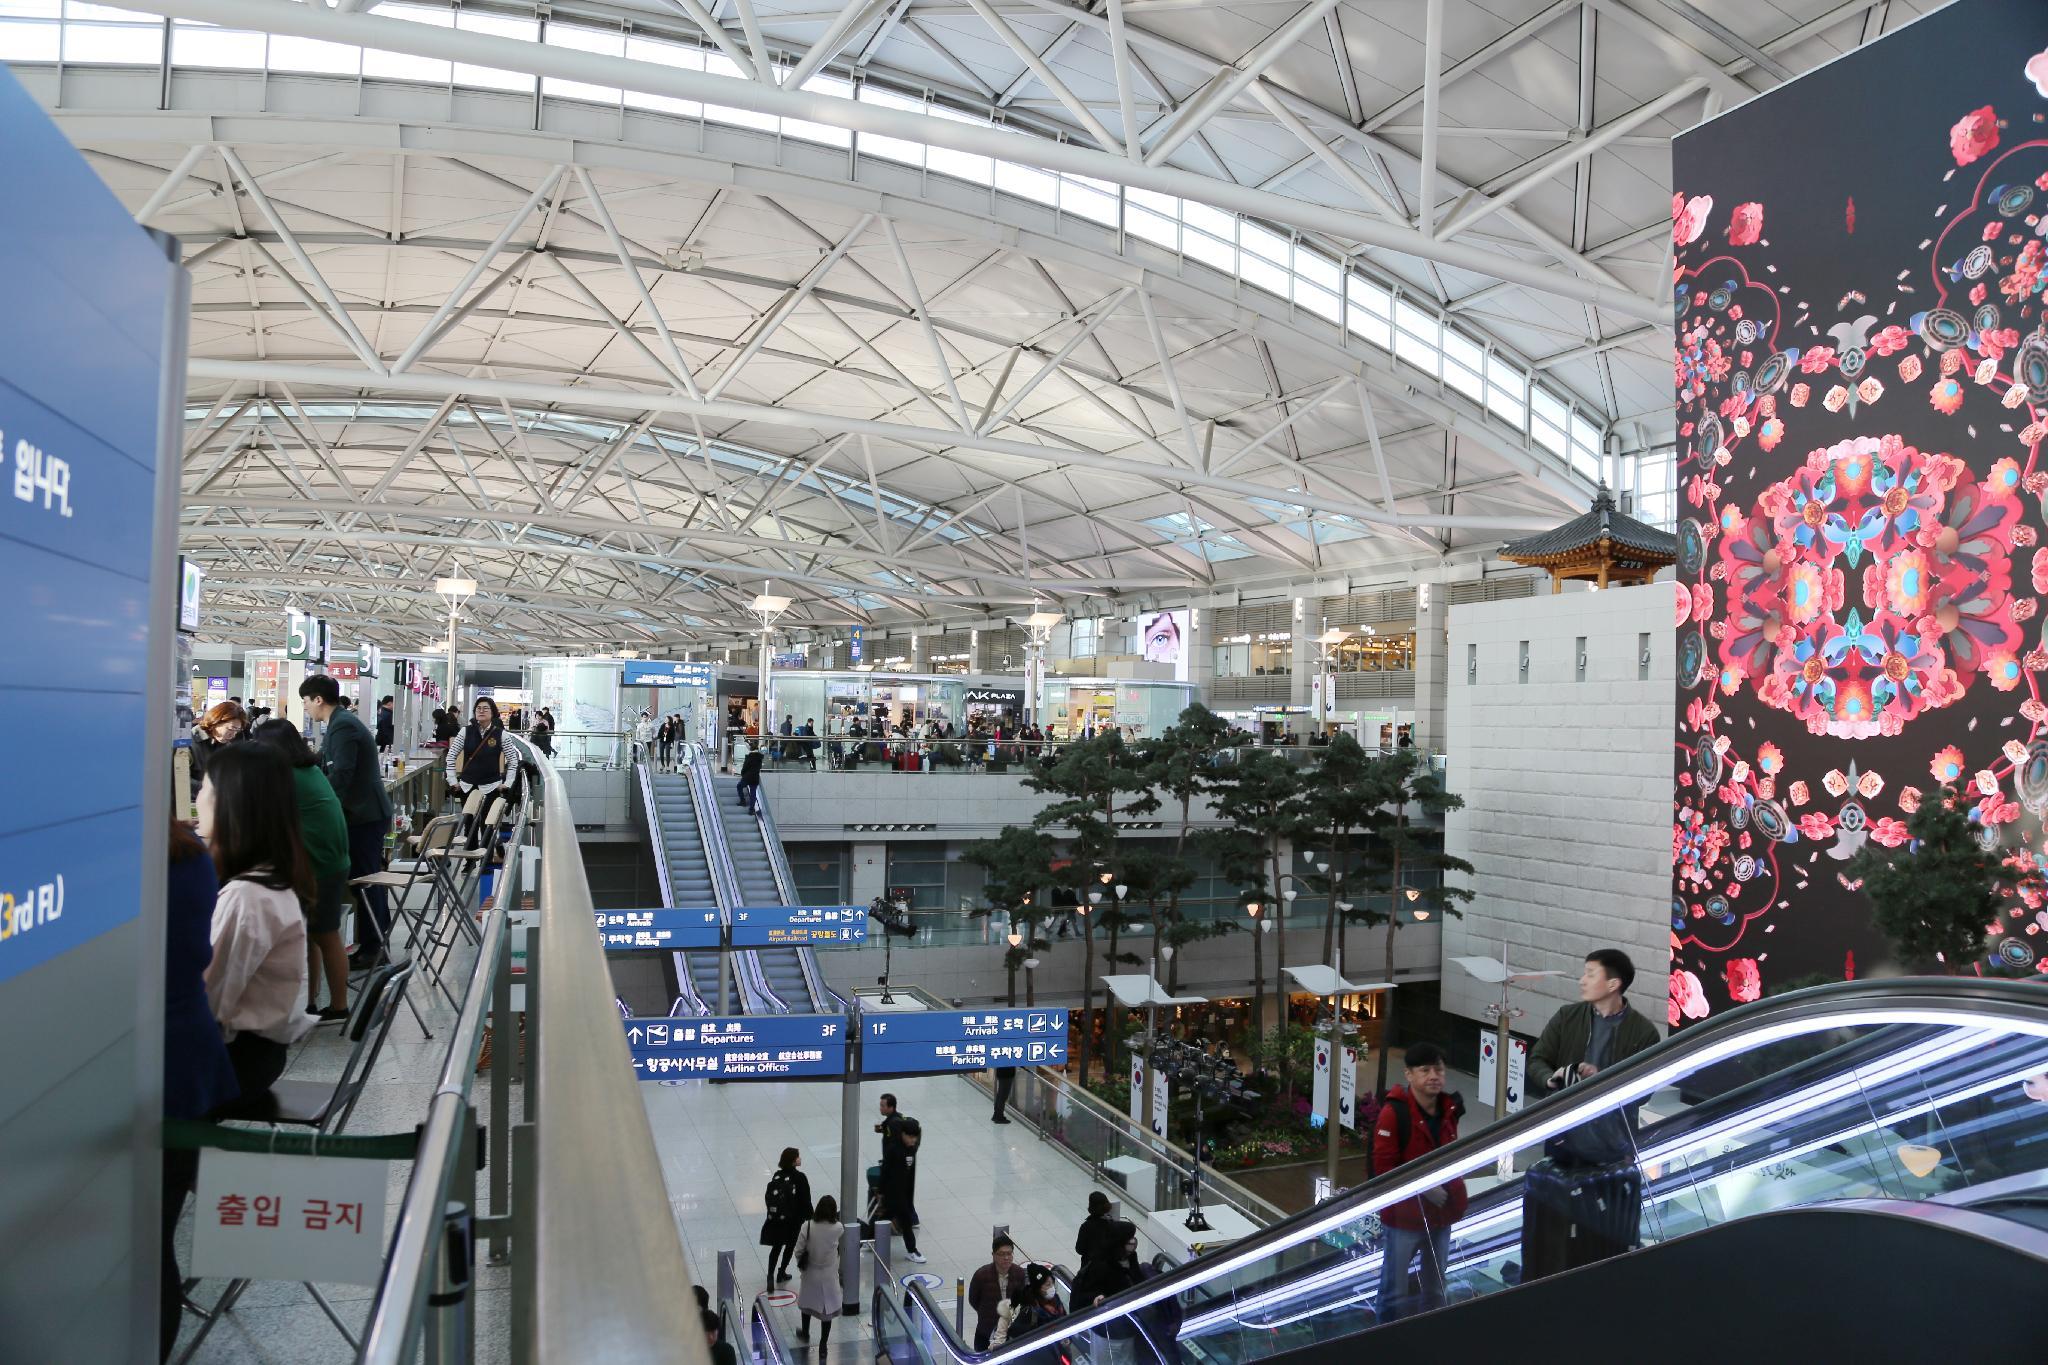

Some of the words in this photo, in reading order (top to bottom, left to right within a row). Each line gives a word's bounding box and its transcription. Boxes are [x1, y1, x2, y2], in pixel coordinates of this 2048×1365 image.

[14, 439, 73, 517] 입니다.
[290, 615, 307, 655] 5
[360, 643, 372, 673] 3
[966, 690, 990, 700] AK
[990, 692, 1016, 700] PLAZA
[608, 915, 625, 925] 도착
[704, 913, 715, 922] 1F
[738, 912, 749, 921] 3F
[789, 915, 822, 924] Departures
[872, 1023, 887, 1035] 1F
[1002, 1018, 1024, 1031] 도착
[673, 1028, 696, 1041] 출발
[821, 1025, 837, 1037] 3F
[964, 1026, 999, 1036] Arrivals
[700, 1034, 755, 1046] Departures
[990, 1046, 1024, 1060] 주차장
[646, 1056, 719, 1072] 항공사사무실
[952, 1055, 986, 1067] Parking
[723, 1064, 756, 1073] Airline
[757, 1062, 790, 1073] Offices
[217, 1194, 281, 1227] 출입
[302, 1199, 363, 1234] 금지
